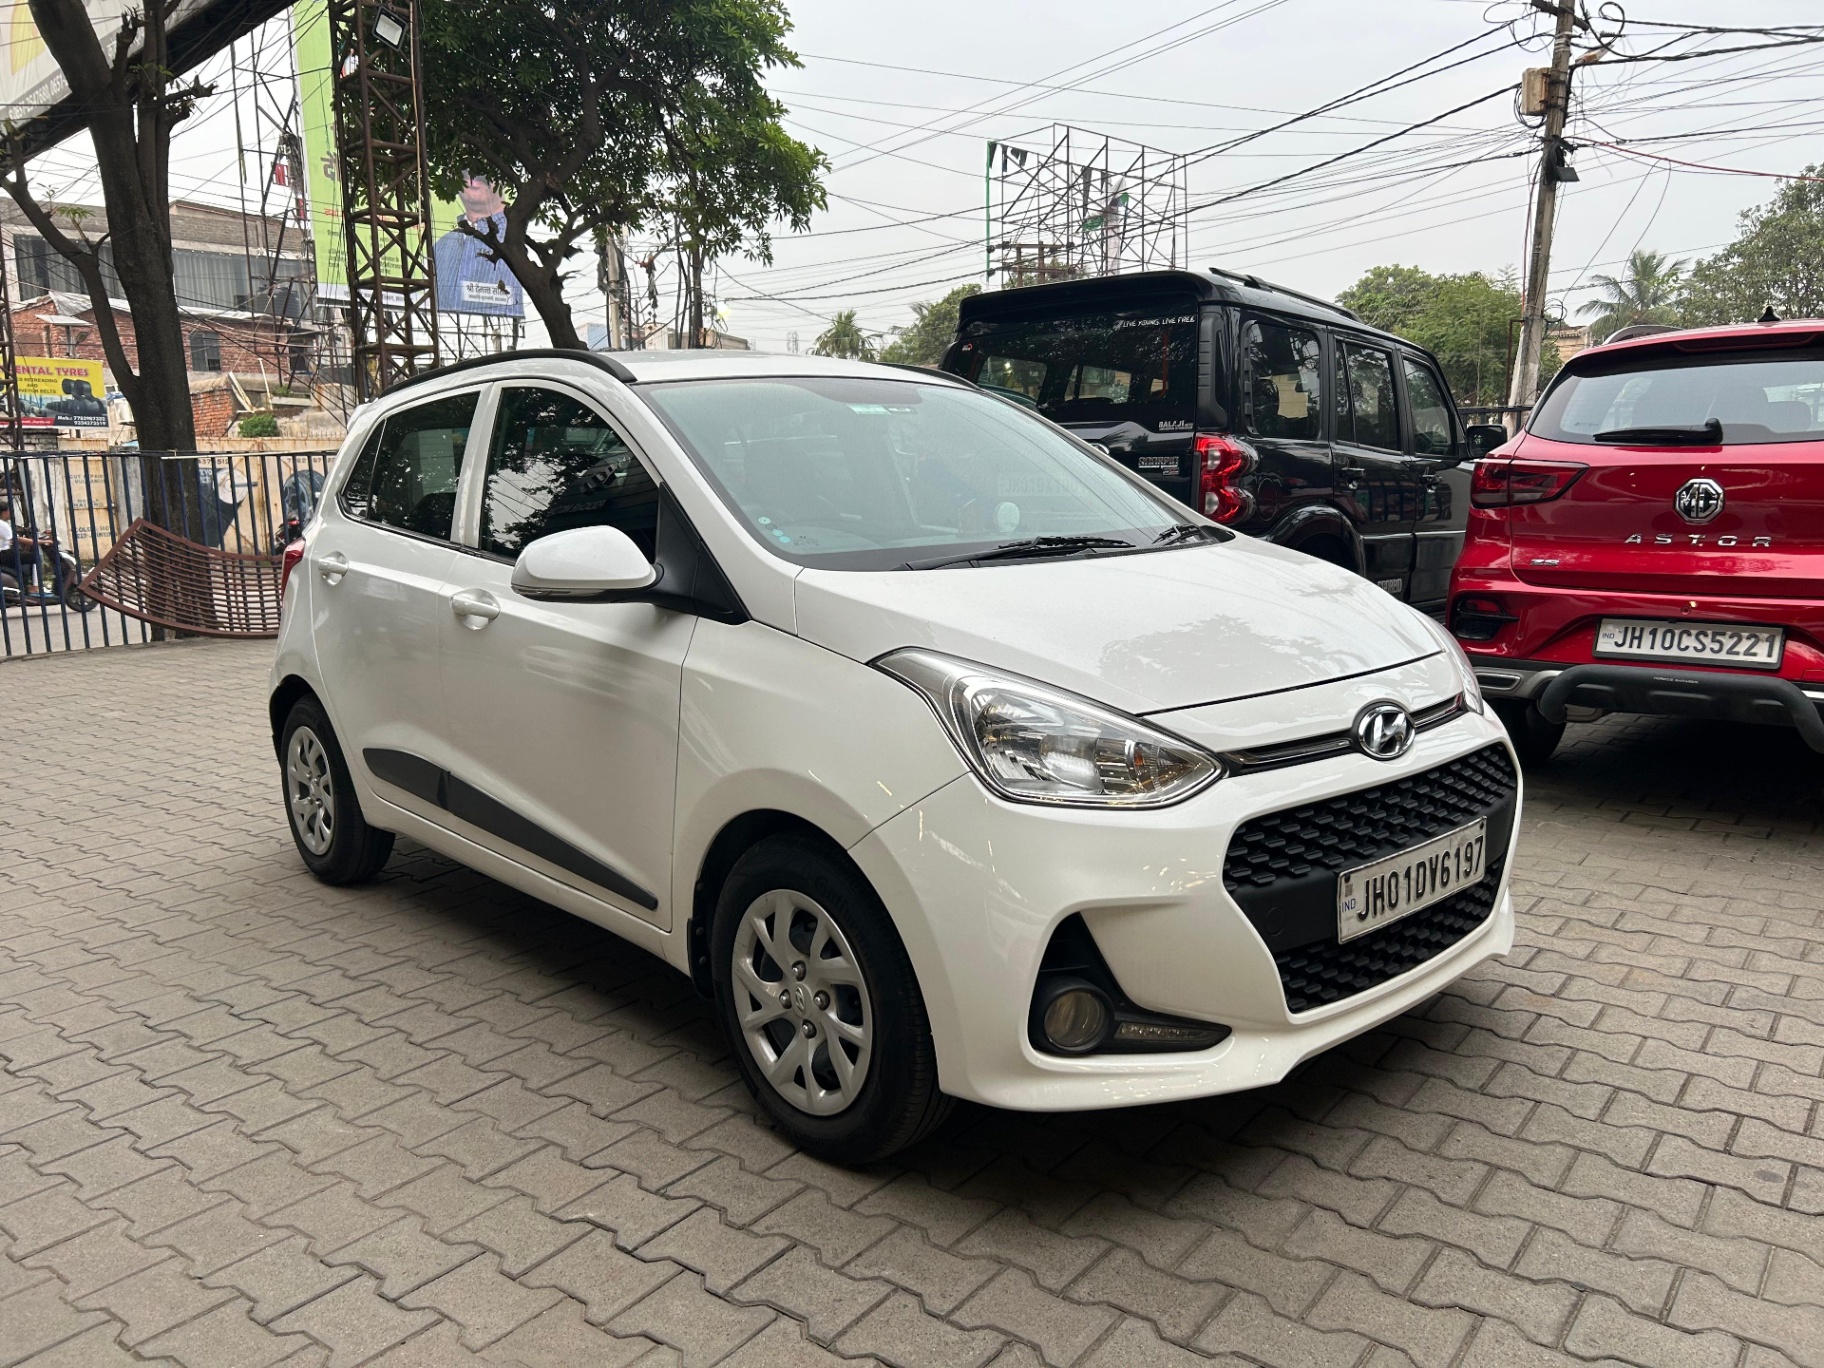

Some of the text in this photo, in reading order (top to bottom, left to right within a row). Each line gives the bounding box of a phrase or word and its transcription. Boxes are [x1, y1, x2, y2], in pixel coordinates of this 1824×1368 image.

[1162, 317, 1176, 325] LIVE
[1177, 315, 1195, 323] FREE
[54, 367, 89, 377] TYRES
[1679, 480, 1721, 521] MG
[1624, 533, 1772, 548] ASTOR
[1602, 632, 1615, 640] IND
[1614, 626, 1776, 658] JH10CS5221
[1356, 835, 1484, 921] JH01DV6197
[1341, 898, 1357, 913] IND
